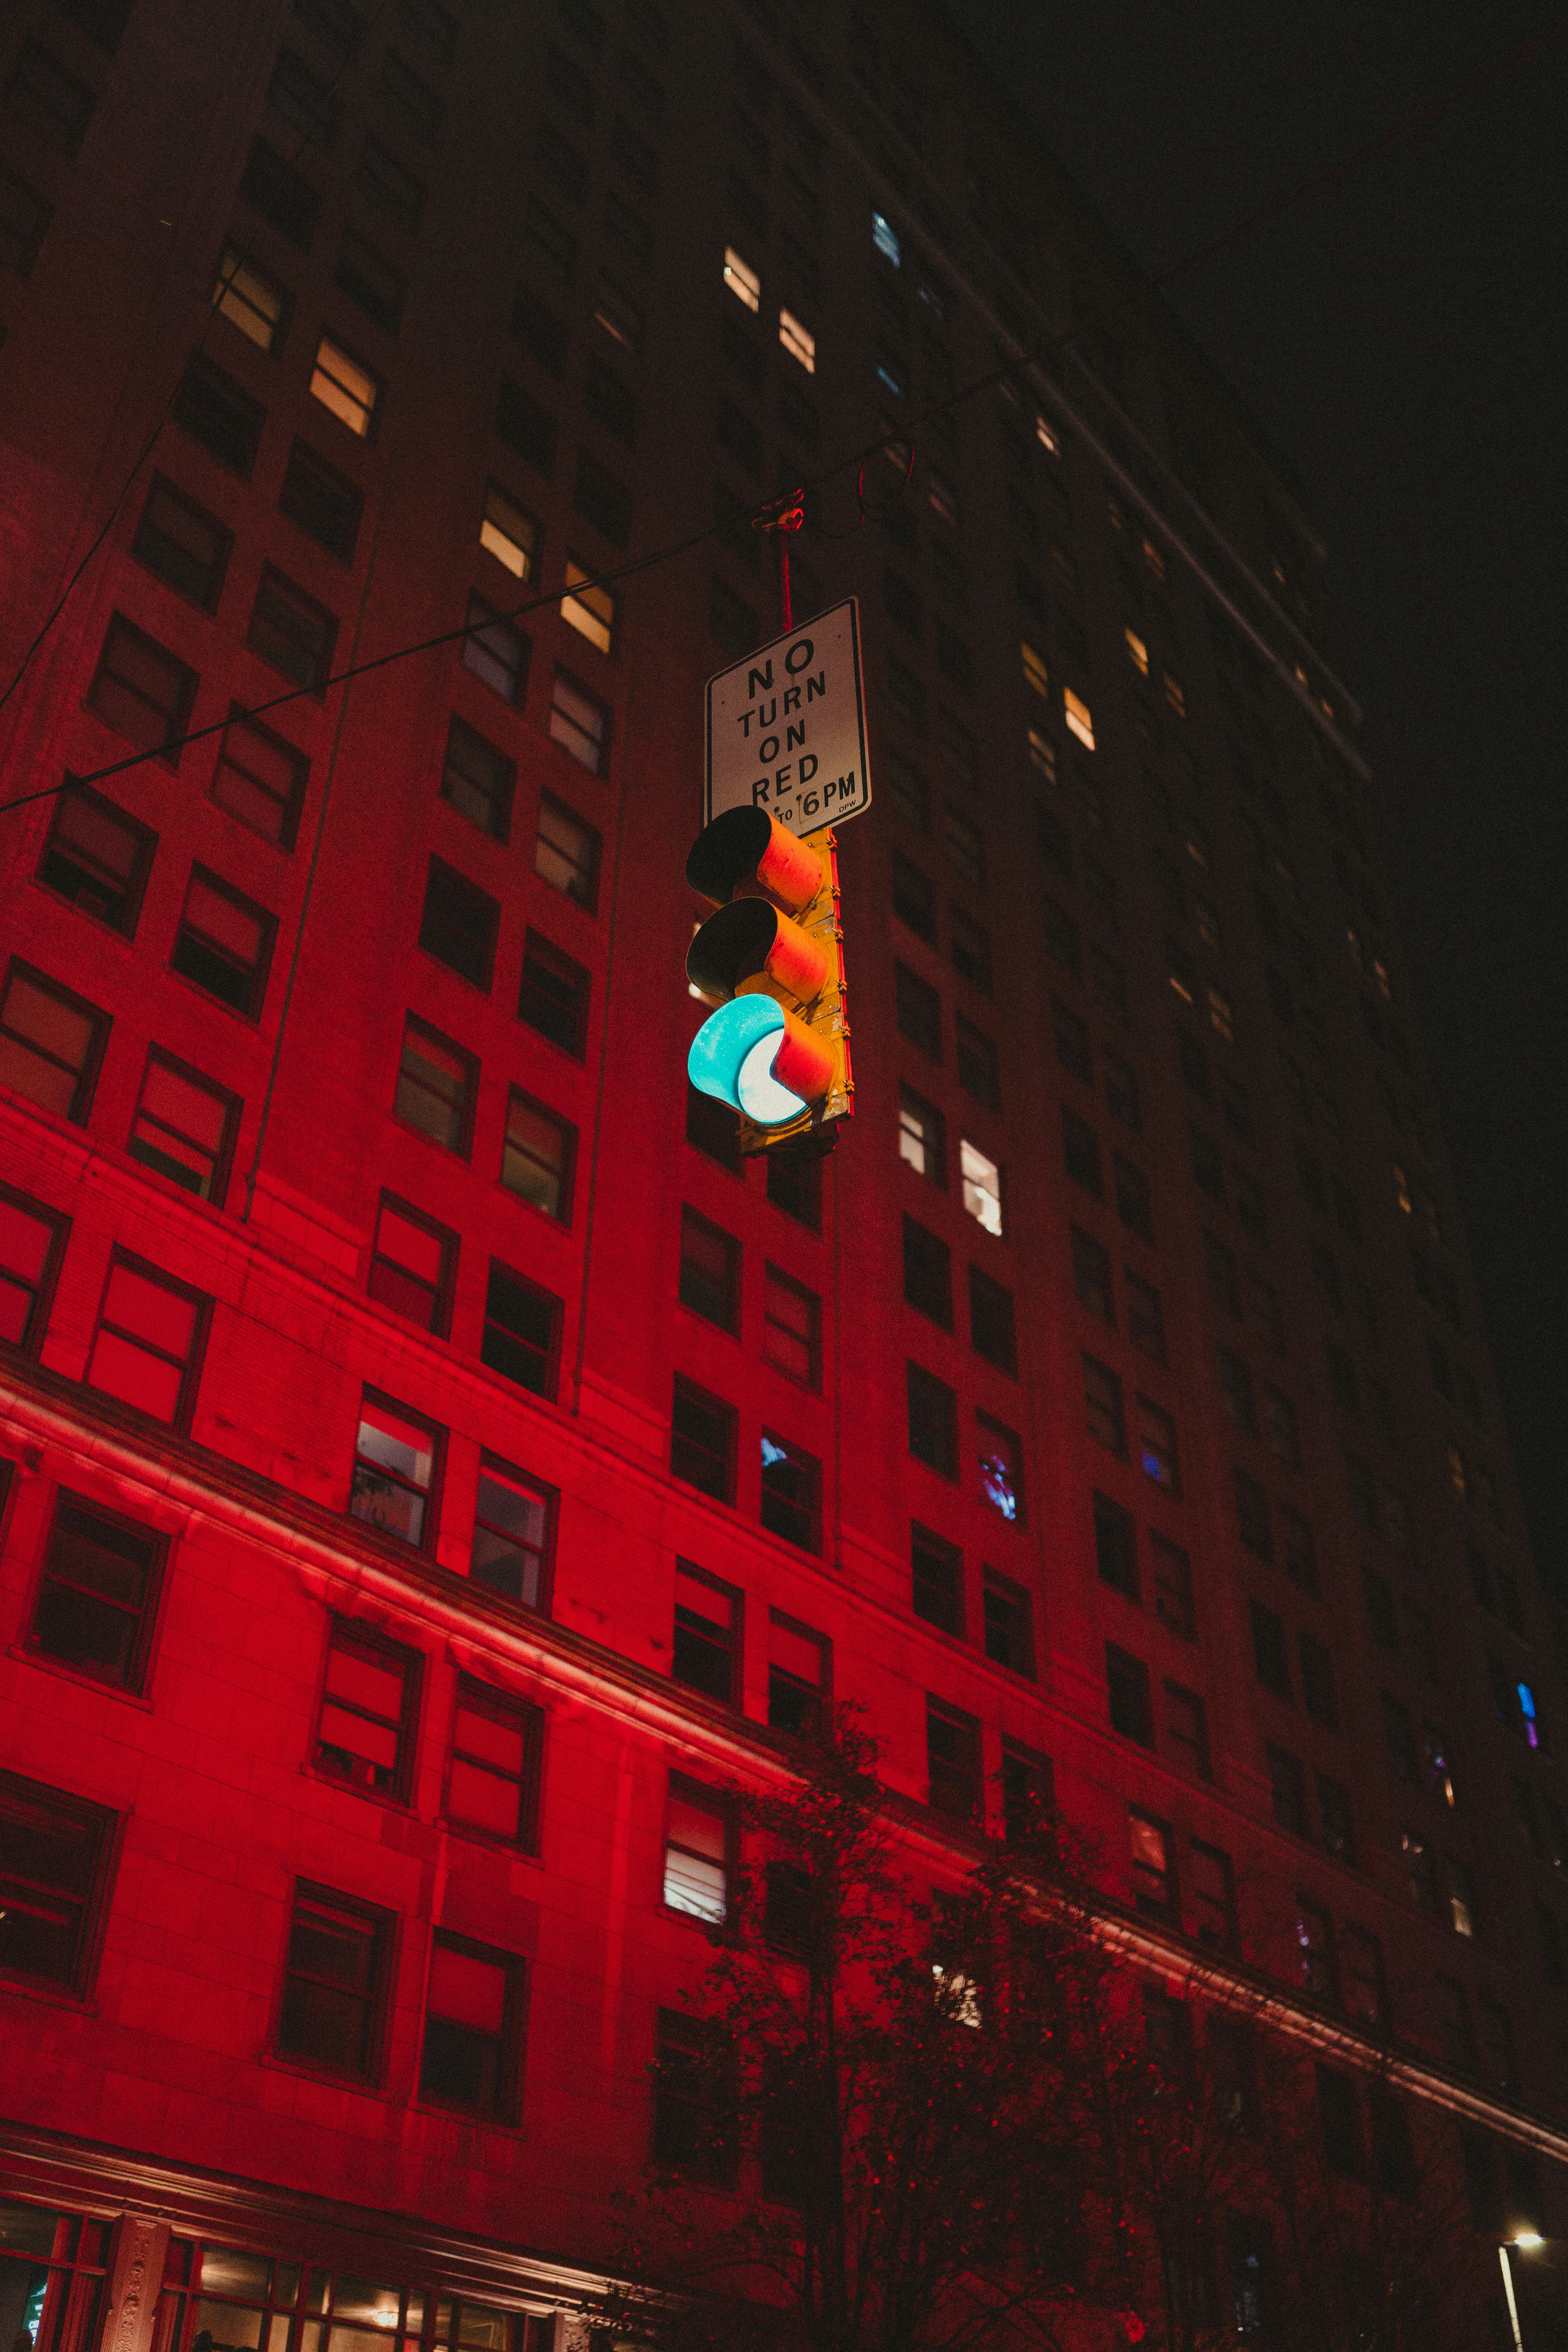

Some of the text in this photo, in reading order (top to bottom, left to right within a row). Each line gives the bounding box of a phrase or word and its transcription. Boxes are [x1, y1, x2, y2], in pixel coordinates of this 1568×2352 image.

[749, 639, 814, 699] NO
[737, 671, 826, 738] TURN
[759, 719, 806, 764] ON
[752, 755, 818, 806] RED
[778, 771, 856, 823] TO 6PM
[839, 800, 856, 813] DPW
